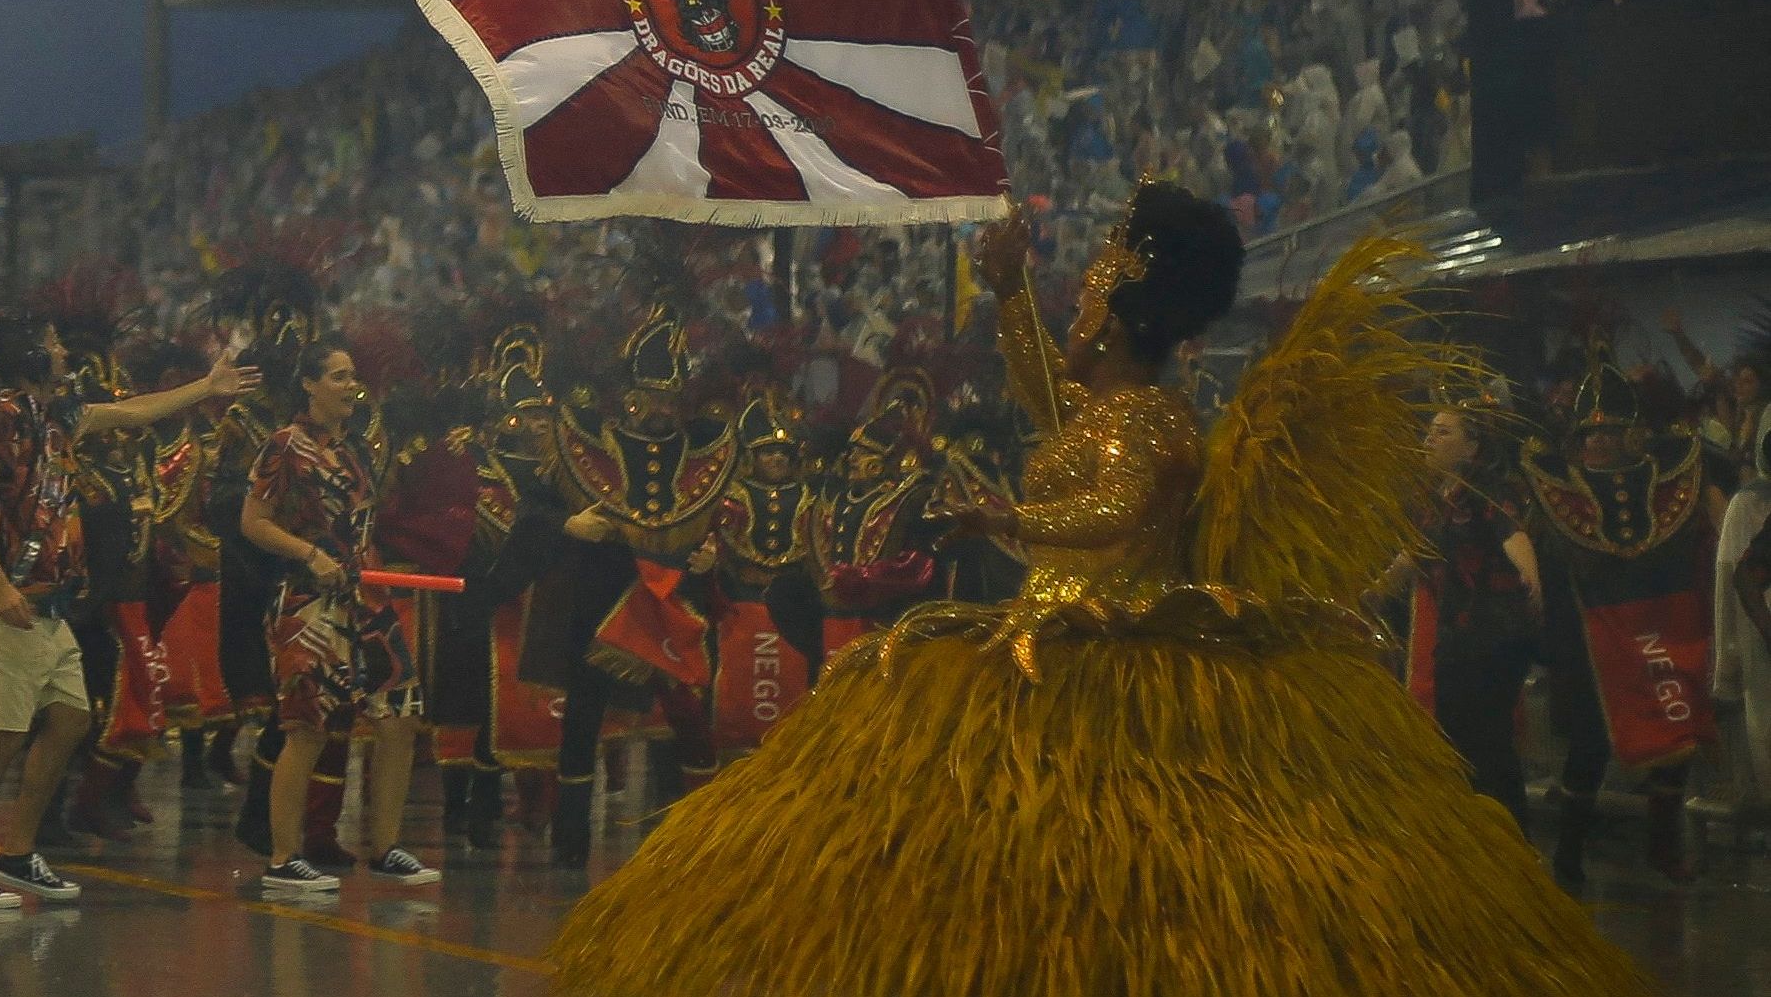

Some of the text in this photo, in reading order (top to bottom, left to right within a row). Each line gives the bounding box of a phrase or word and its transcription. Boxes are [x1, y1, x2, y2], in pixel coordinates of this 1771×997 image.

[633, 17, 785, 95] DRAGÕES DA REAL
[753, 631, 781, 722] NEGO
[1634, 632, 1691, 721] NEGO
